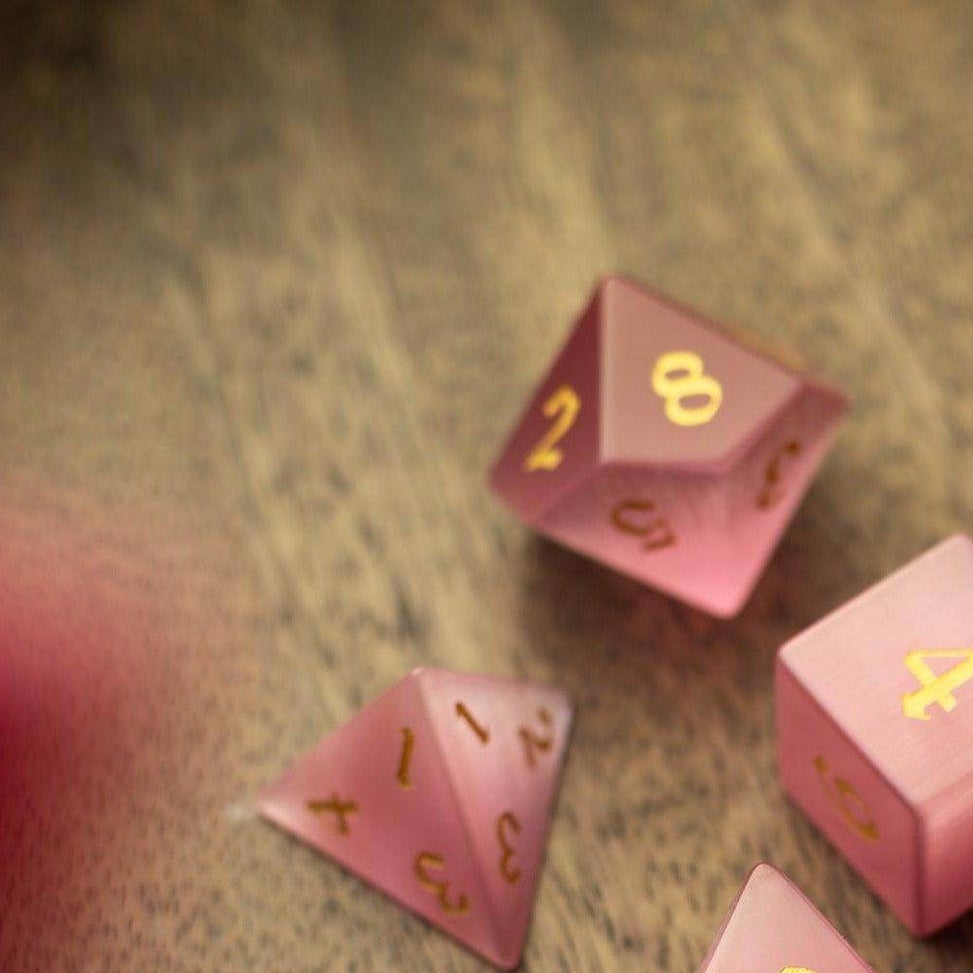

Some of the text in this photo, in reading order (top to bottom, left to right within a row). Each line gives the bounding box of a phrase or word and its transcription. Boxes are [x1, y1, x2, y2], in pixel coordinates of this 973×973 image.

[652, 351, 723, 426] 8
[525, 385, 581, 472] 2
[609, 498, 676, 552] 5
[455, 701, 490, 745] 1
[396, 727, 414, 788] 1
[498, 811, 521, 884] 3
[414, 850, 470, 916] 3
